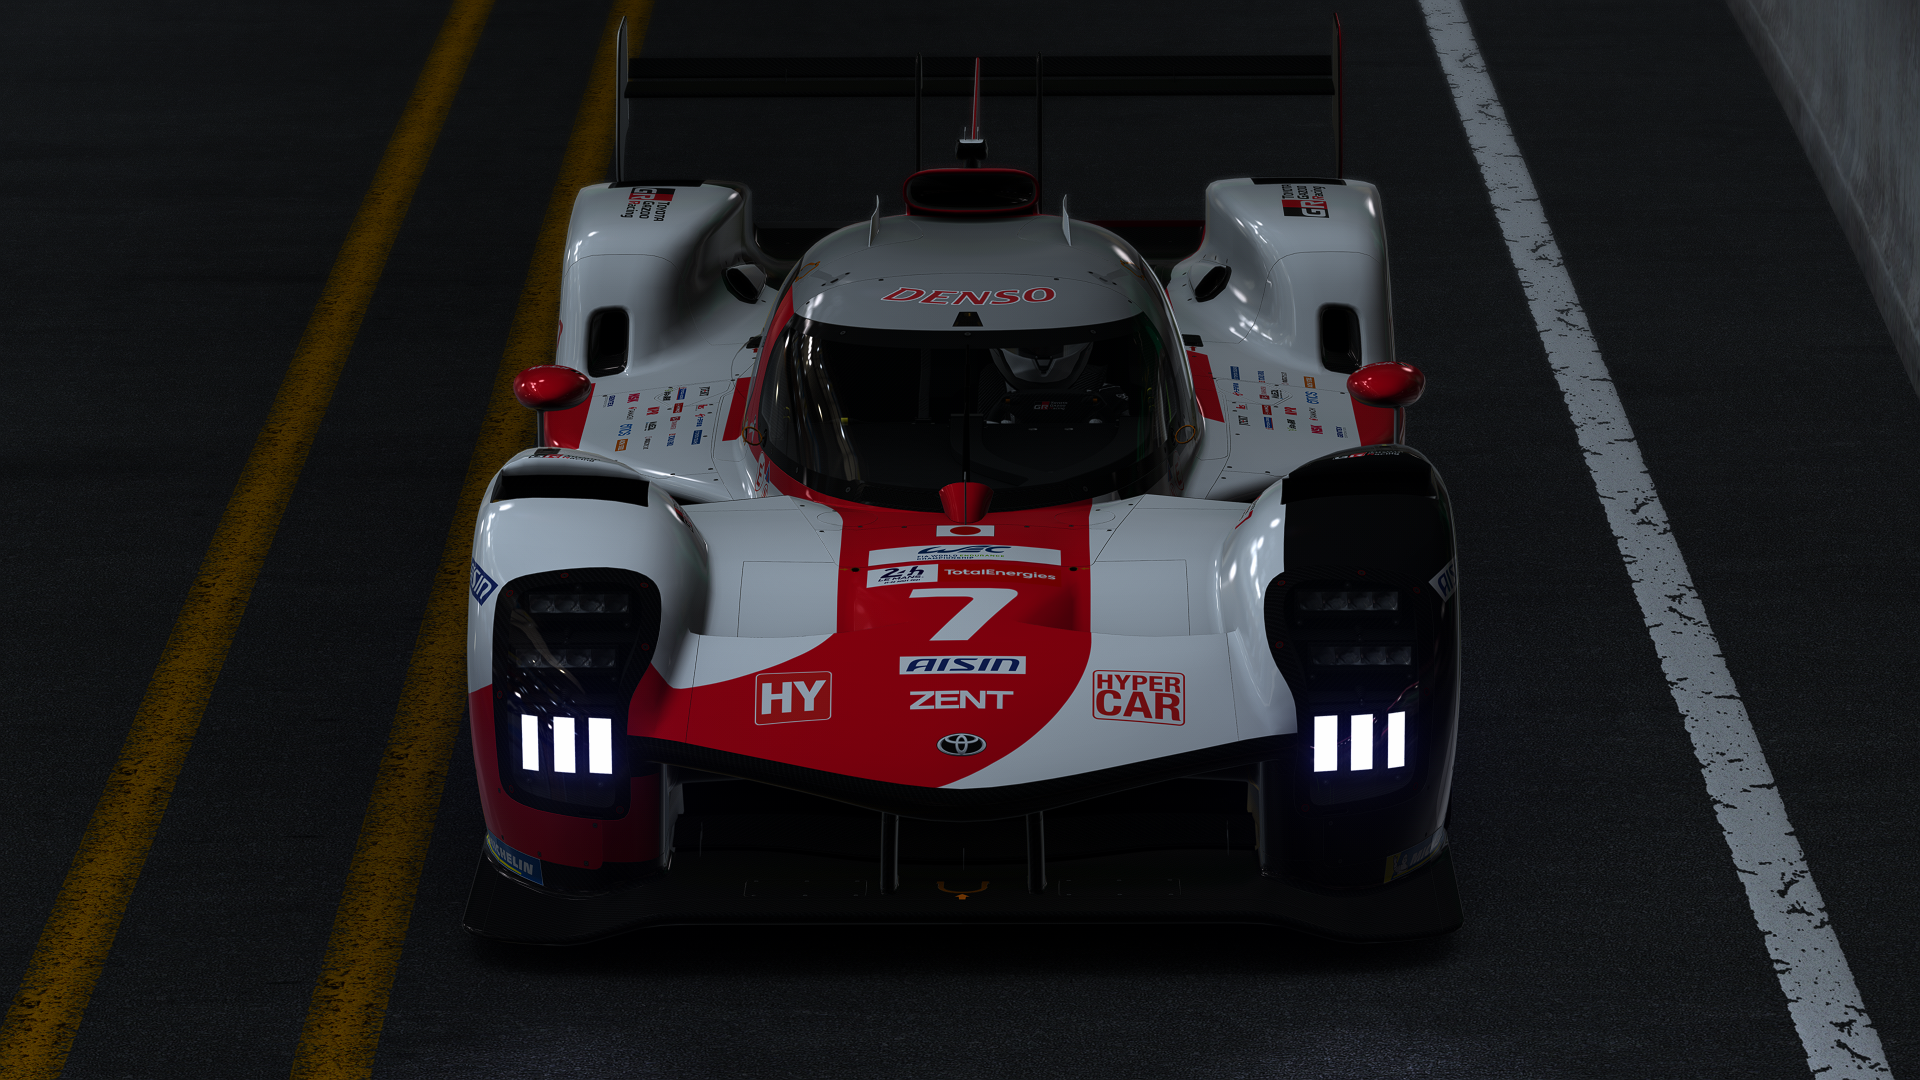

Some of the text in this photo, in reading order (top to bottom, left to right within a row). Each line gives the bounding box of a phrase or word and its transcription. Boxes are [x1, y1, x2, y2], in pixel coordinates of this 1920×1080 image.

[881, 287, 1057, 306] DENSO
[918, 545, 1011, 554] WEC
[944, 569, 1056, 580] TotalEnergies
[908, 587, 1019, 641] 7
[906, 658, 1020, 672] AISIN
[1097, 674, 1181, 693] HYPER
[761, 680, 827, 715] HY
[910, 690, 1014, 710] ZENT
[1096, 690, 1181, 721] CAR
